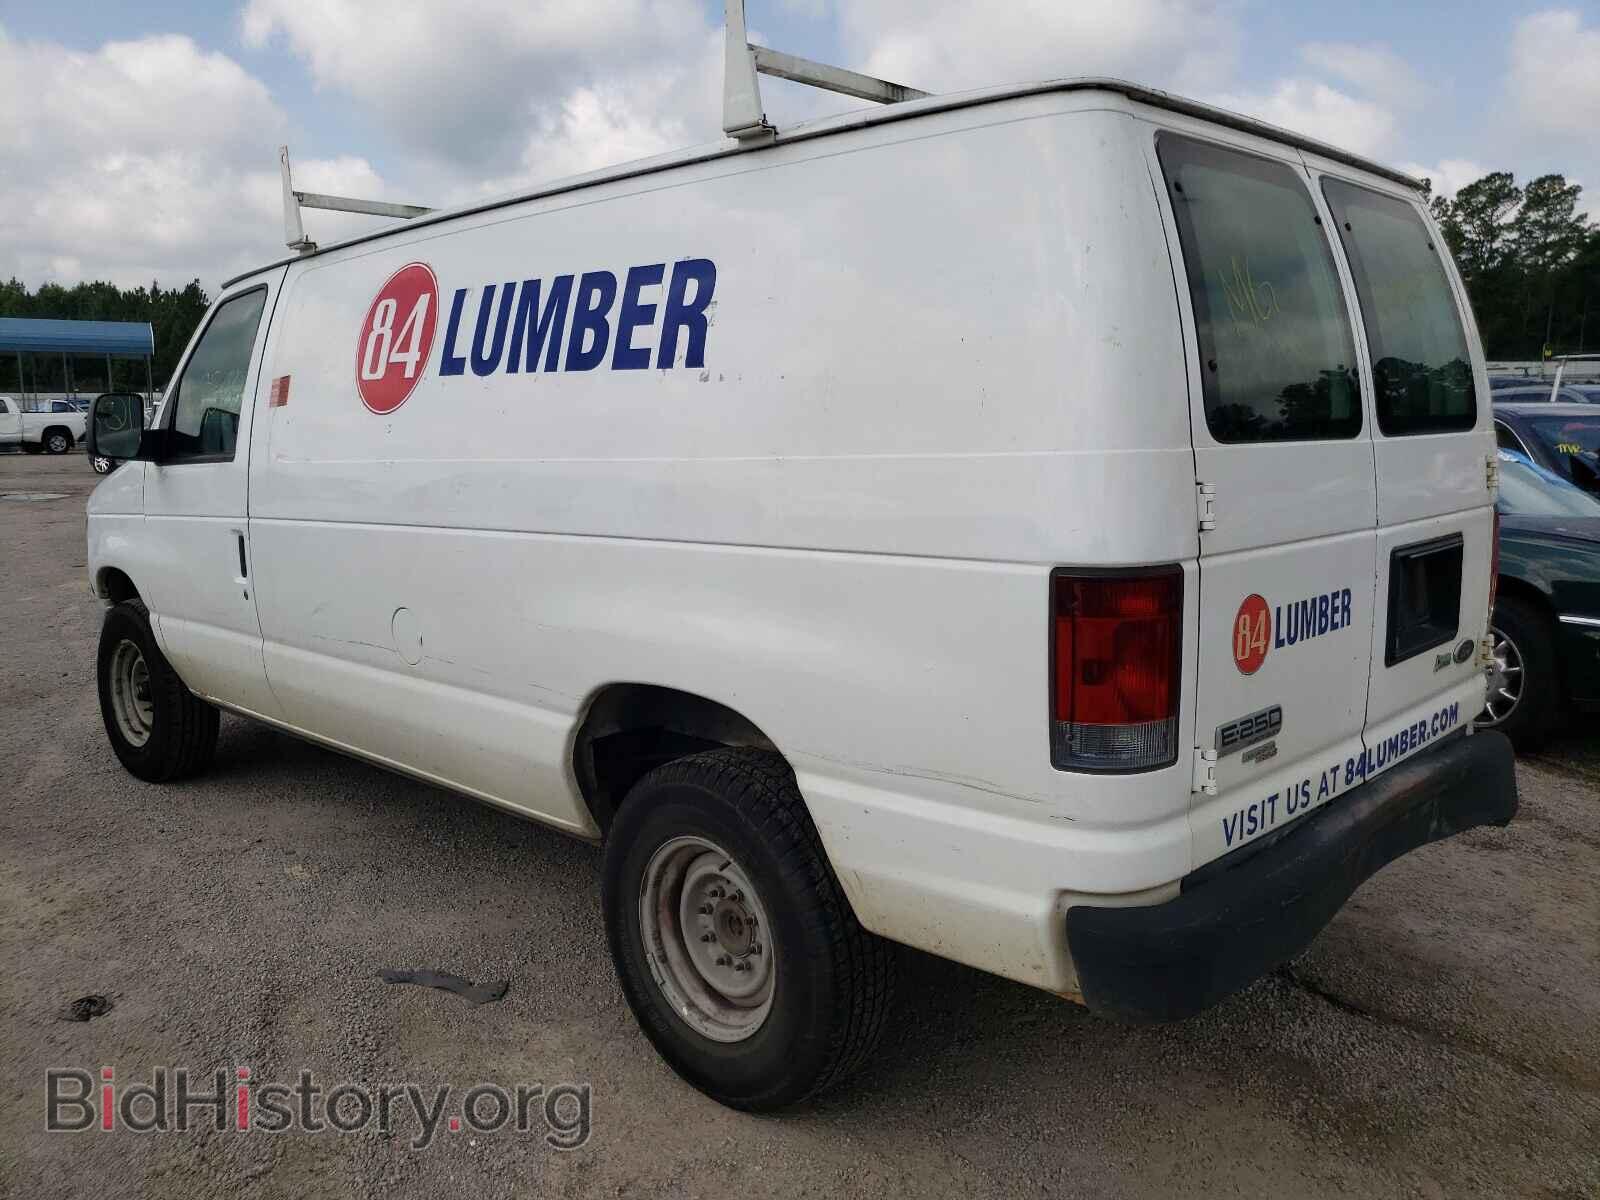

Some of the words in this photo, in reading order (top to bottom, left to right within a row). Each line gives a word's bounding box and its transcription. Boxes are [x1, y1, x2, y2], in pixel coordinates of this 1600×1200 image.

[361, 292, 431, 381] 84
[438, 258, 717, 377] LUMBER
[1236, 609, 1267, 661] 84
[1274, 588, 1351, 649] LUMBER
[1220, 706, 1282, 747] E-250
[1222, 793, 1279, 848] VISIT
[1286, 778, 1311, 815] US
[1317, 765, 1341, 801] AT
[1344, 702, 1458, 786] 84LUMBER.COM
